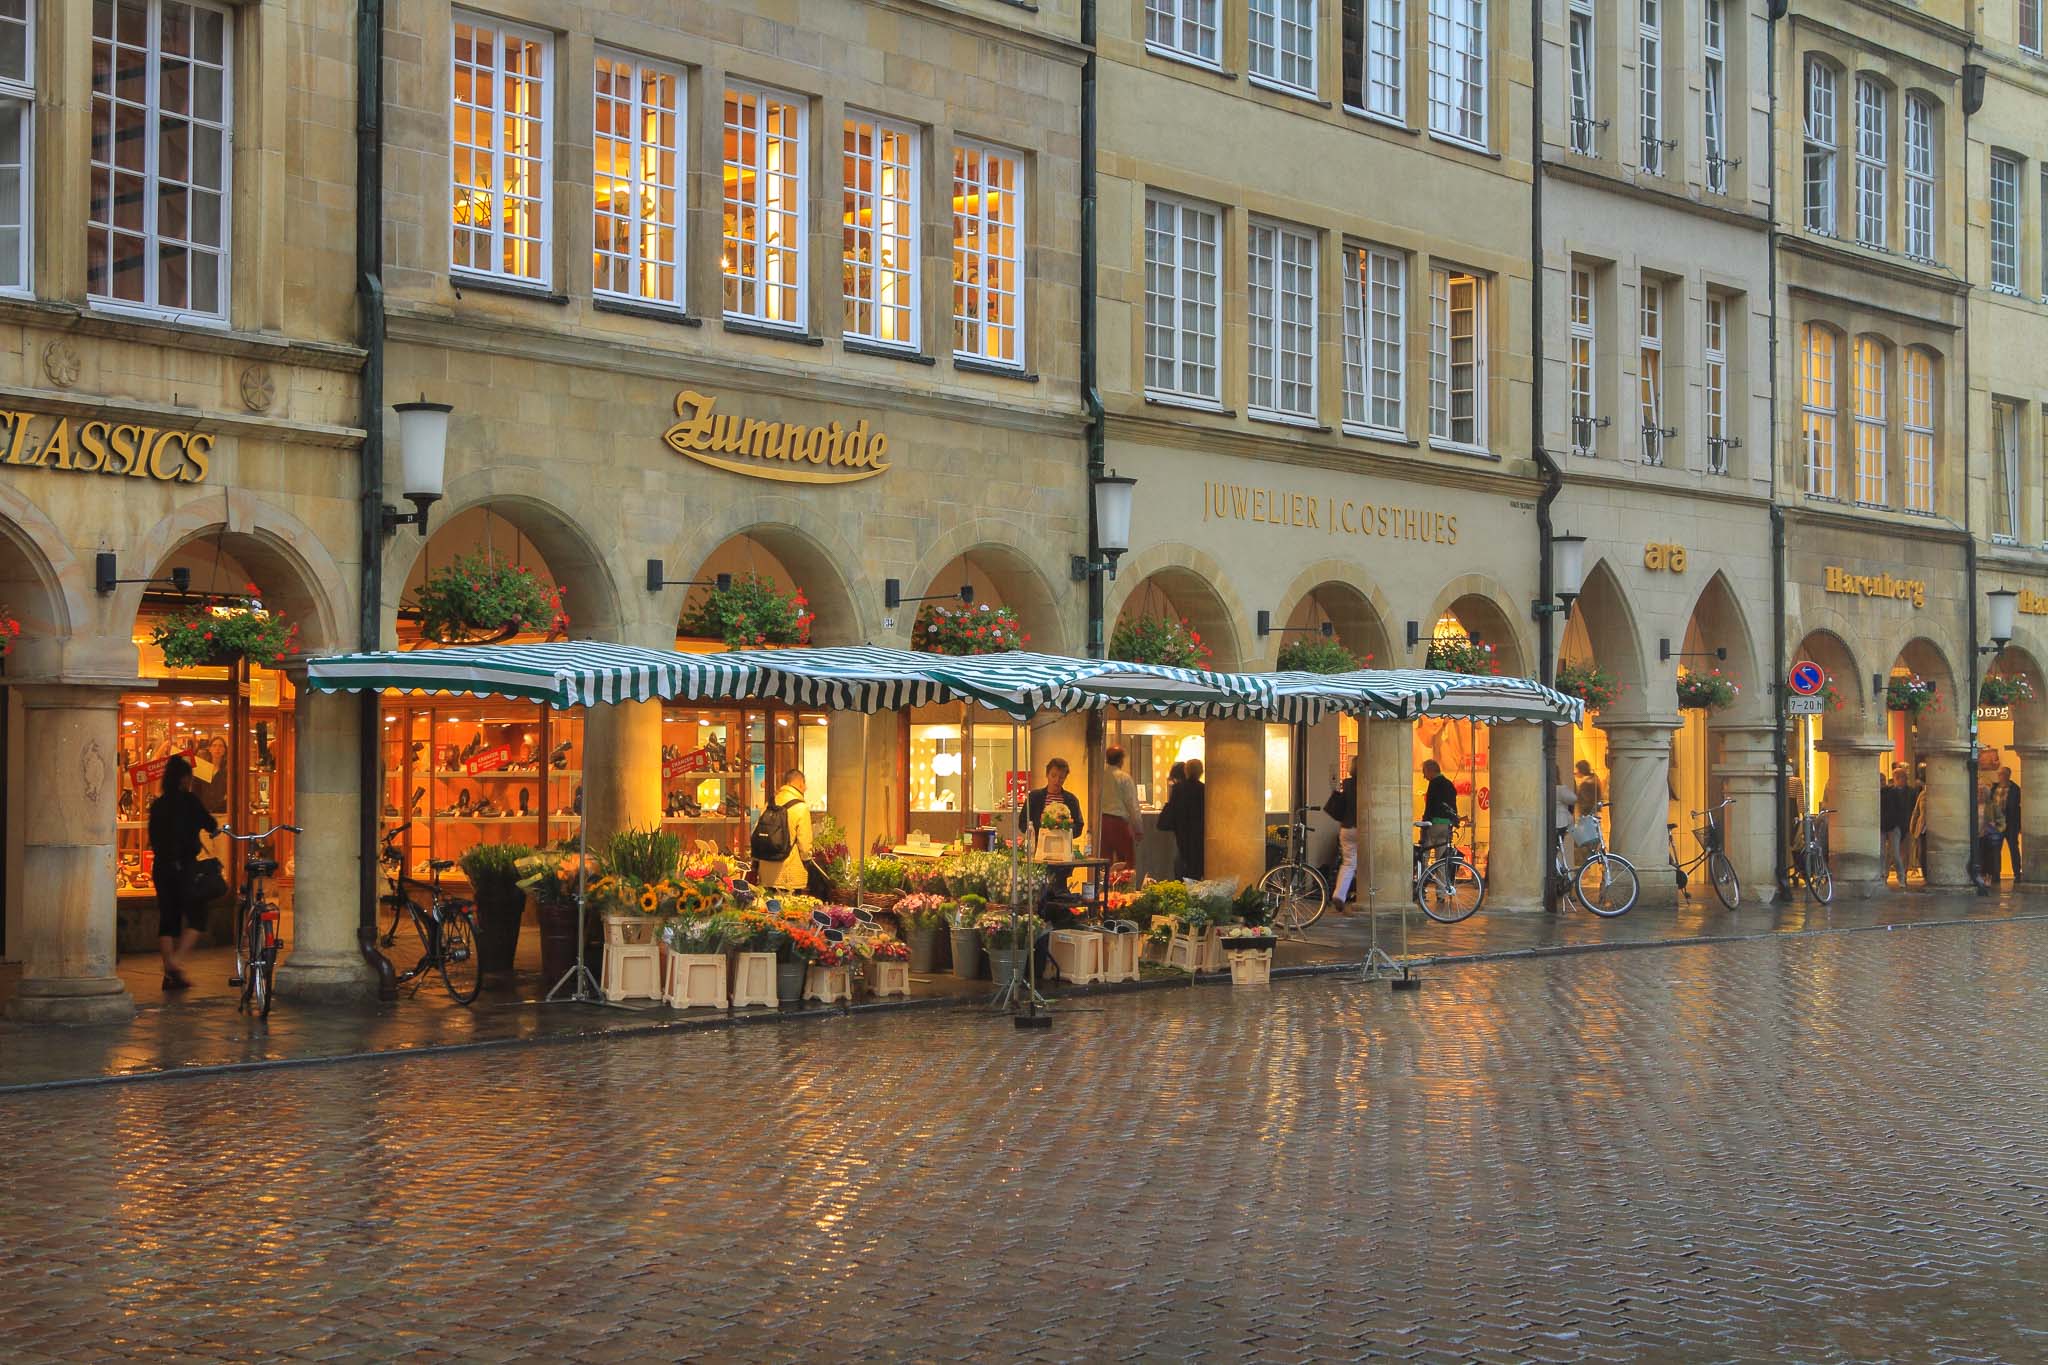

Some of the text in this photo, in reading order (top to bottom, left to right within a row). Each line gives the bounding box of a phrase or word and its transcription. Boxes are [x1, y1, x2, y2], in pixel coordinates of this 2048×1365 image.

[1203, 480, 1321, 529] JUWELIER
[1645, 543, 1687, 573] ara
[1825, 565, 1926, 609] Harenberg
